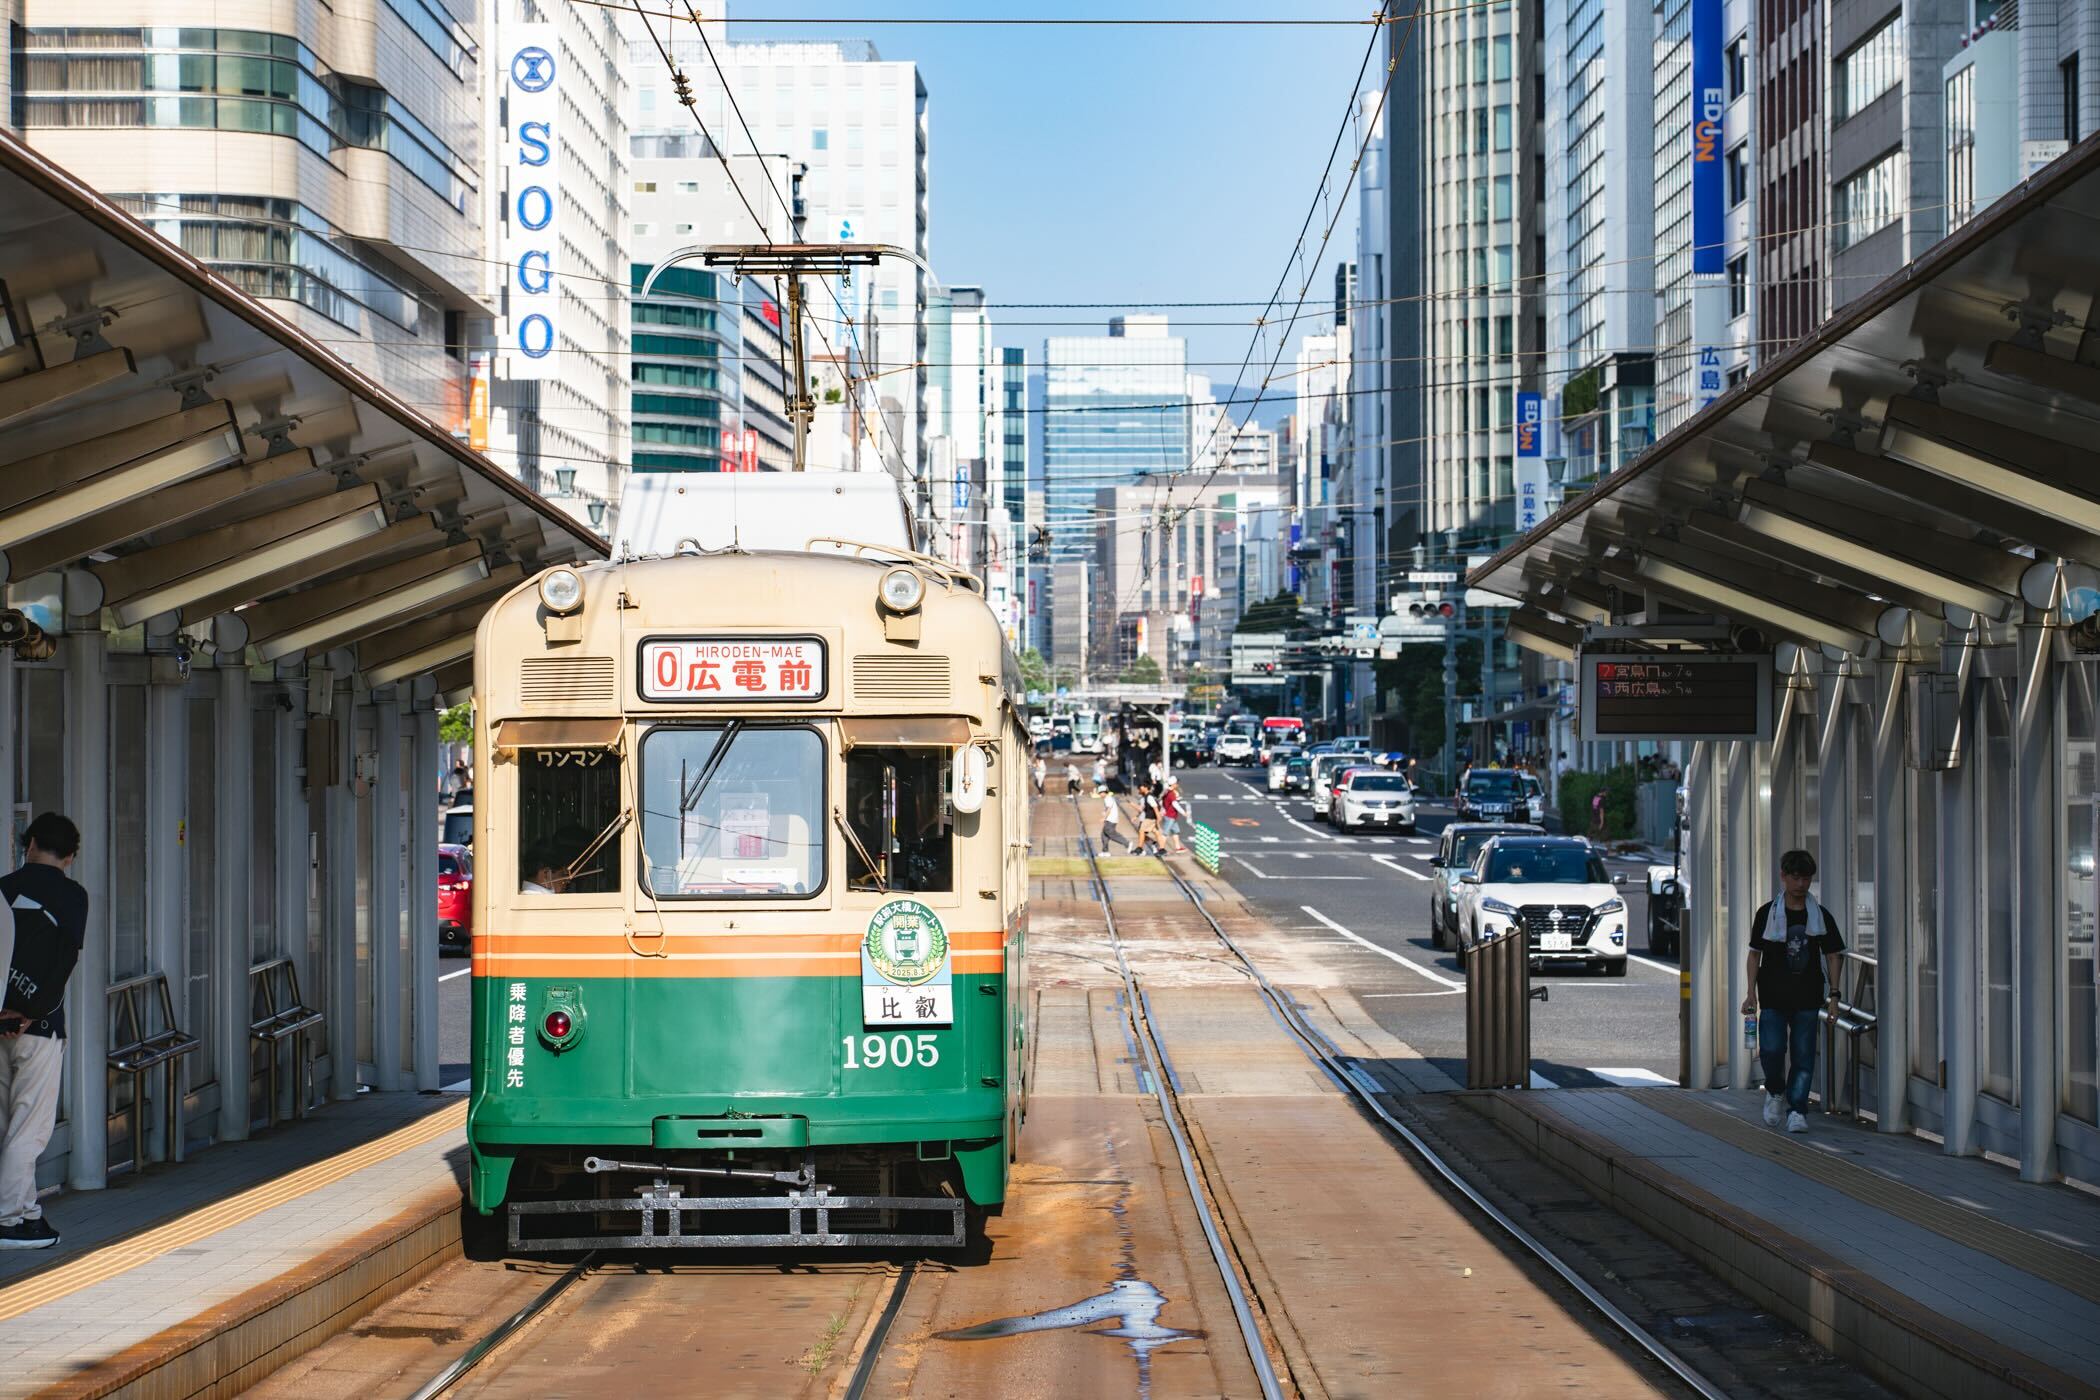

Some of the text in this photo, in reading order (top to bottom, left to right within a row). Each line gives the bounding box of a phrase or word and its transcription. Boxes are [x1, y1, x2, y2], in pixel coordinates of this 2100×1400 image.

[1695, 88, 1723, 162] EDION
[516, 121, 554, 359] SOGO
[1519, 399, 1538, 450] EDION
[695, 646, 803, 658] HIRODEN-MAE
[657, 651, 812, 692] 0 広電前
[537, 750, 603, 767] ワンマン
[872, 901, 937, 927] 駅前大橋ルート
[893, 914, 920, 929] 開業
[891, 968, 926, 977] 2025.8.3
[881, 986, 936, 994] ひえい
[881, 995, 938, 1019] 比叡
[506, 982, 527, 1088] 乗降者優先
[842, 1034, 940, 1069] 1905
